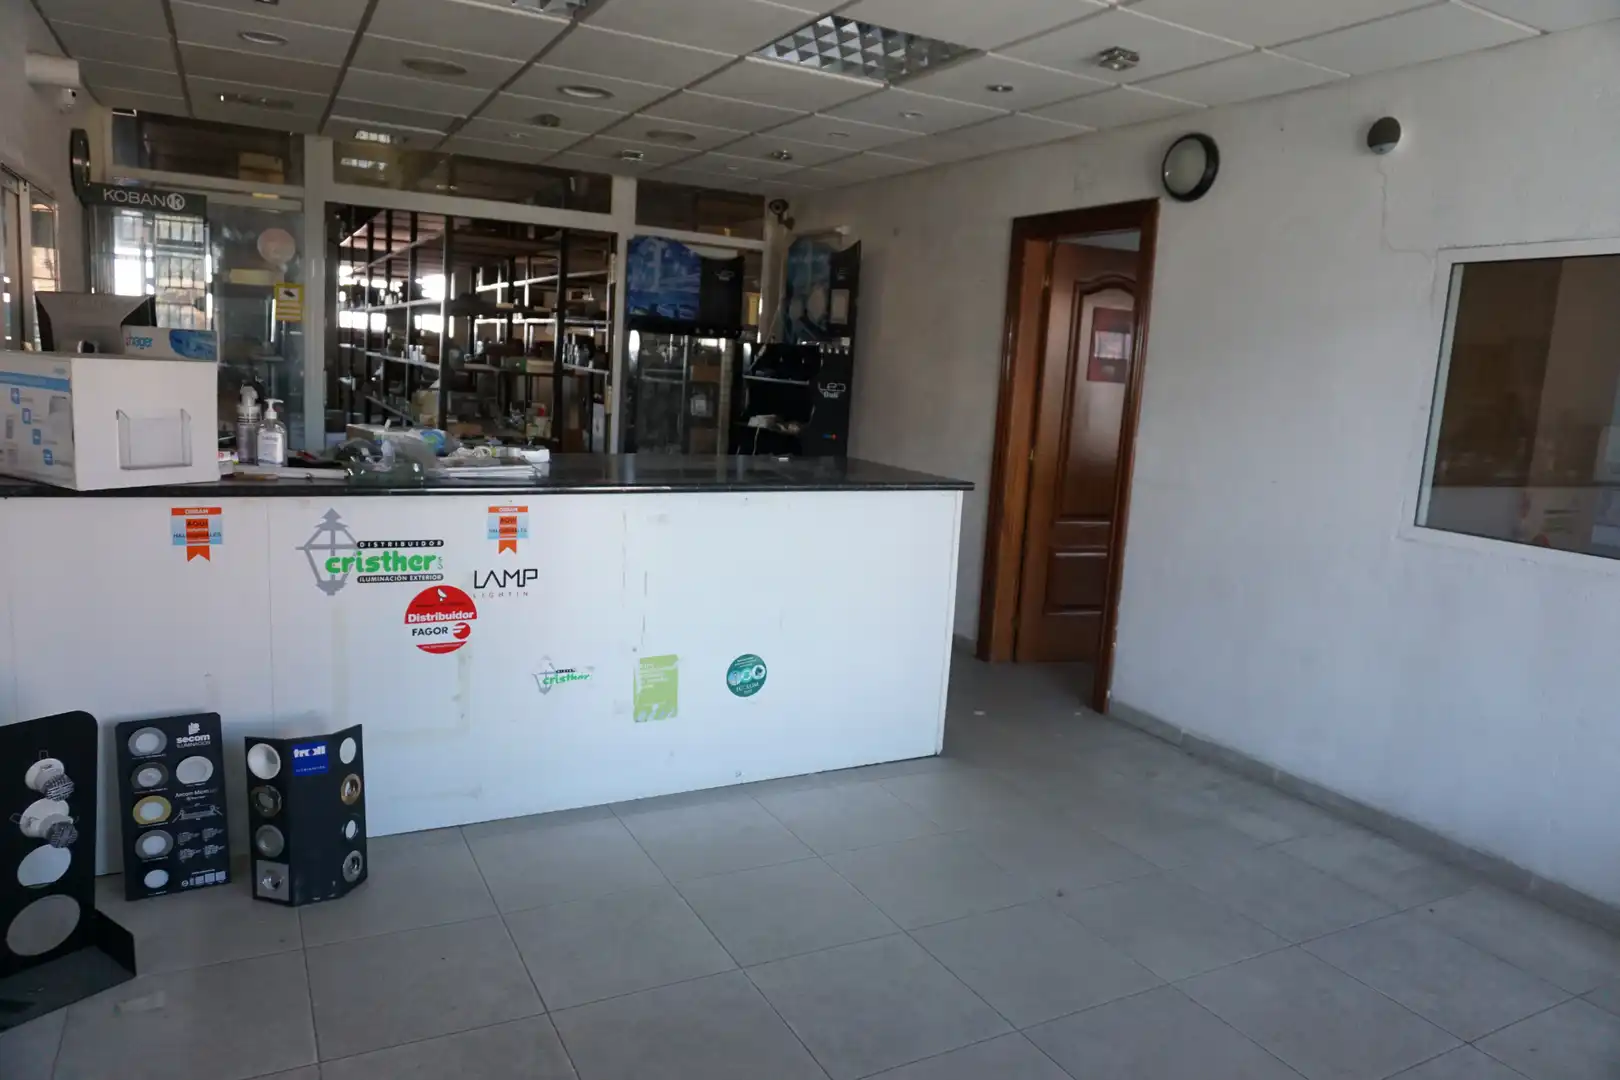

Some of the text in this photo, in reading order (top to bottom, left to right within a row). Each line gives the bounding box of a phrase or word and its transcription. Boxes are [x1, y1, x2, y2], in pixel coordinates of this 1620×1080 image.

[103, 188, 166, 208] KOBAN
[359, 539, 443, 549] DISTRIBUIDOR
[324, 550, 437, 574] cristher
[409, 573, 442, 582] EXTERIOR
[474, 568, 538, 589] LAMP
[408, 610, 475, 623] Distribuidor
[411, 626, 449, 637] FAGOR
[176, 734, 211, 744] secom
